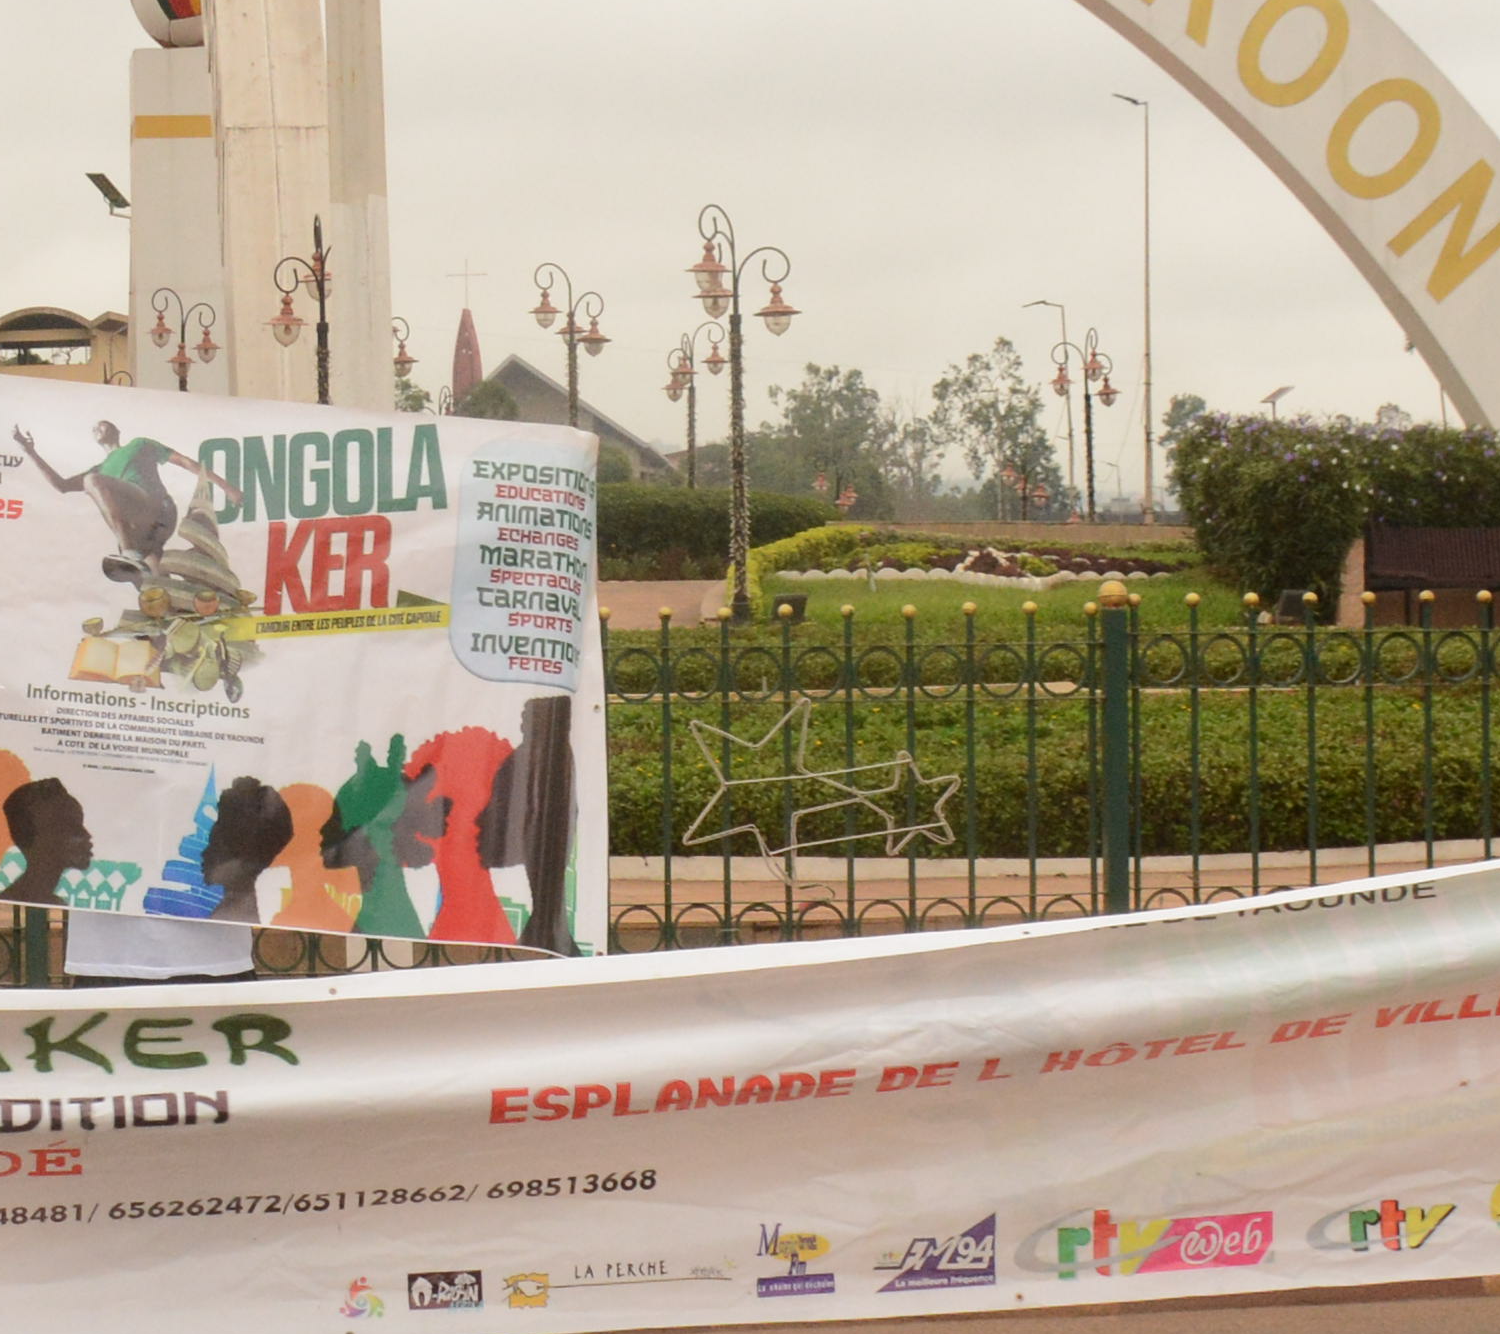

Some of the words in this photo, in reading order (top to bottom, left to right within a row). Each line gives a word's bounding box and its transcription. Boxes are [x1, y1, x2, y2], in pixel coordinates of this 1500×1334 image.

[198, 423, 448, 525] ONGOLA
[497, 527, 579, 551] ECHANGES
[264, 515, 392, 616] KER
[508, 612, 573, 634] SPORTS
[508, 656, 562, 674] FETES
[26, 683, 136, 708] Informations
[151, 696, 250, 719] Inscriptions
[487, 1067, 858, 1125] ESPLANADE
[875, 1060, 959, 1095] DE
[1040, 1028, 1247, 1075] HÔTEL
[1269, 1012, 1352, 1044] DE
[108, 1183, 478, 1221] 656262472/651128662/
[486, 1168, 658, 1201] 698513668
[574, 1264, 594, 1279] LA
[606, 1260, 669, 1278] PERCHE
